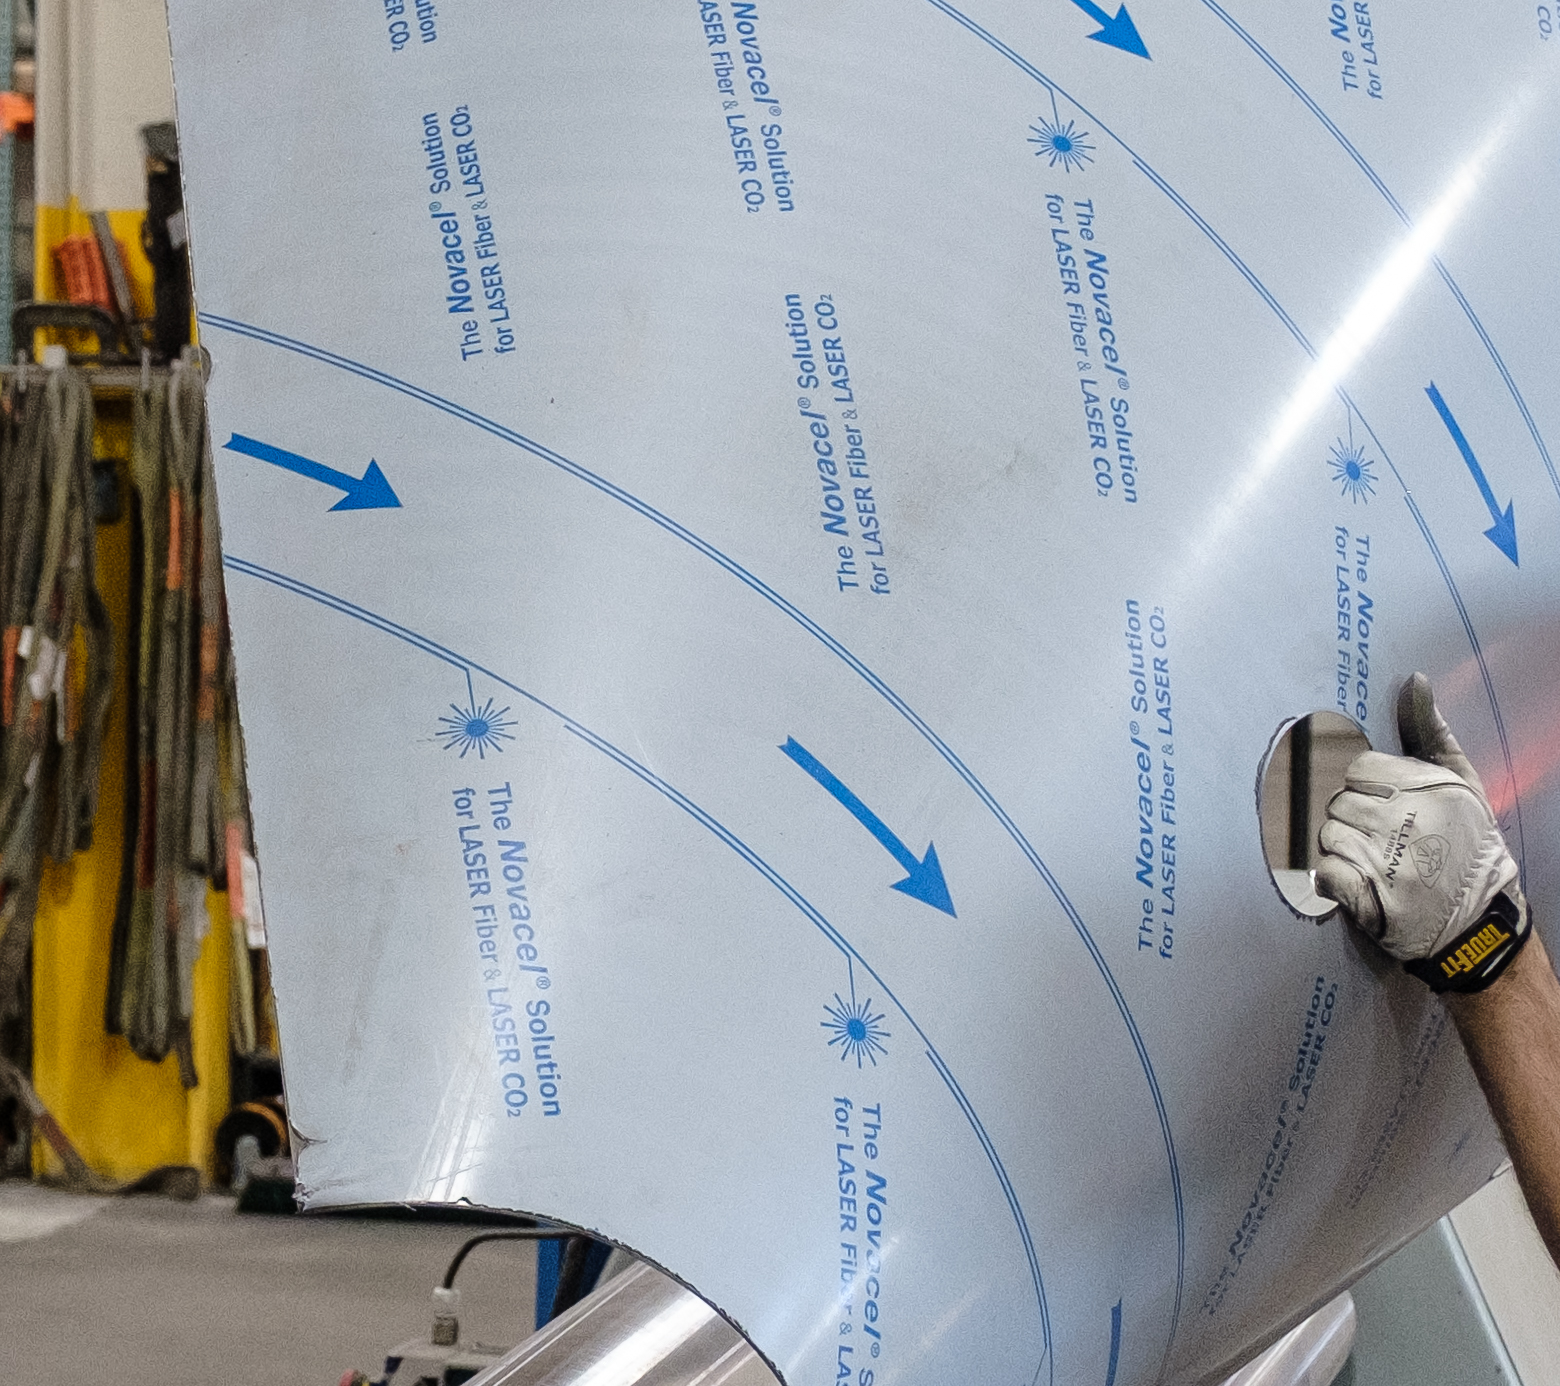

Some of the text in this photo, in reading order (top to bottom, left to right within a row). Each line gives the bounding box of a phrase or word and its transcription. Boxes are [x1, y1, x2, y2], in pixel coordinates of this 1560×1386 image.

[1354, 2, 1378, 65] LASER
[1341, 50, 1359, 91] The
[1367, 69, 1383, 99] for
[711, 51, 735, 96] Fiber
[726, 114, 757, 174] LASER
[421, 112, 451, 194] Solution
[456, 139, 485, 198] LASER
[760, 124, 794, 212] Solution
[474, 214, 498, 259] Fiber
[1045, 194, 1064, 224] for
[1051, 228, 1080, 294] LASER
[481, 262, 510, 323] LASER
[460, 320, 483, 361] The
[494, 327, 516, 354] for
[785, 294, 819, 389] Solution
[1066, 302, 1088, 356] Fiber
[1074, 199, 1095, 241] The
[1110, 397, 1138, 503] Solution
[822, 337, 854, 402] LASER
[1080, 379, 1107, 449] LASER
[845, 424, 870, 479] Fiber
[854, 486, 884, 556] LASER
[836, 546, 859, 592] The
[870, 562, 891, 594] for
[1356, 535, 1370, 583] The
[1335, 526, 1351, 712] for LASER Fiber
[1125, 599, 1148, 714] Solution
[1153, 657, 1173, 736] LASER
[452, 787, 476, 819] for
[1160, 760, 1176, 825] Fiber
[458, 825, 491, 898] LASER
[1162, 834, 1176, 916] LASER
[472, 904, 498, 962] Fiber
[488, 782, 513, 830] The
[526, 1000, 561, 1116] Solution
[1138, 899, 1154, 951] The
[1159, 922, 1173, 959] for
[487, 987, 521, 1065] LASER
[834, 1097, 853, 1137] for
[863, 1103, 881, 1160] The
[836, 1143, 857, 1232] LASER
